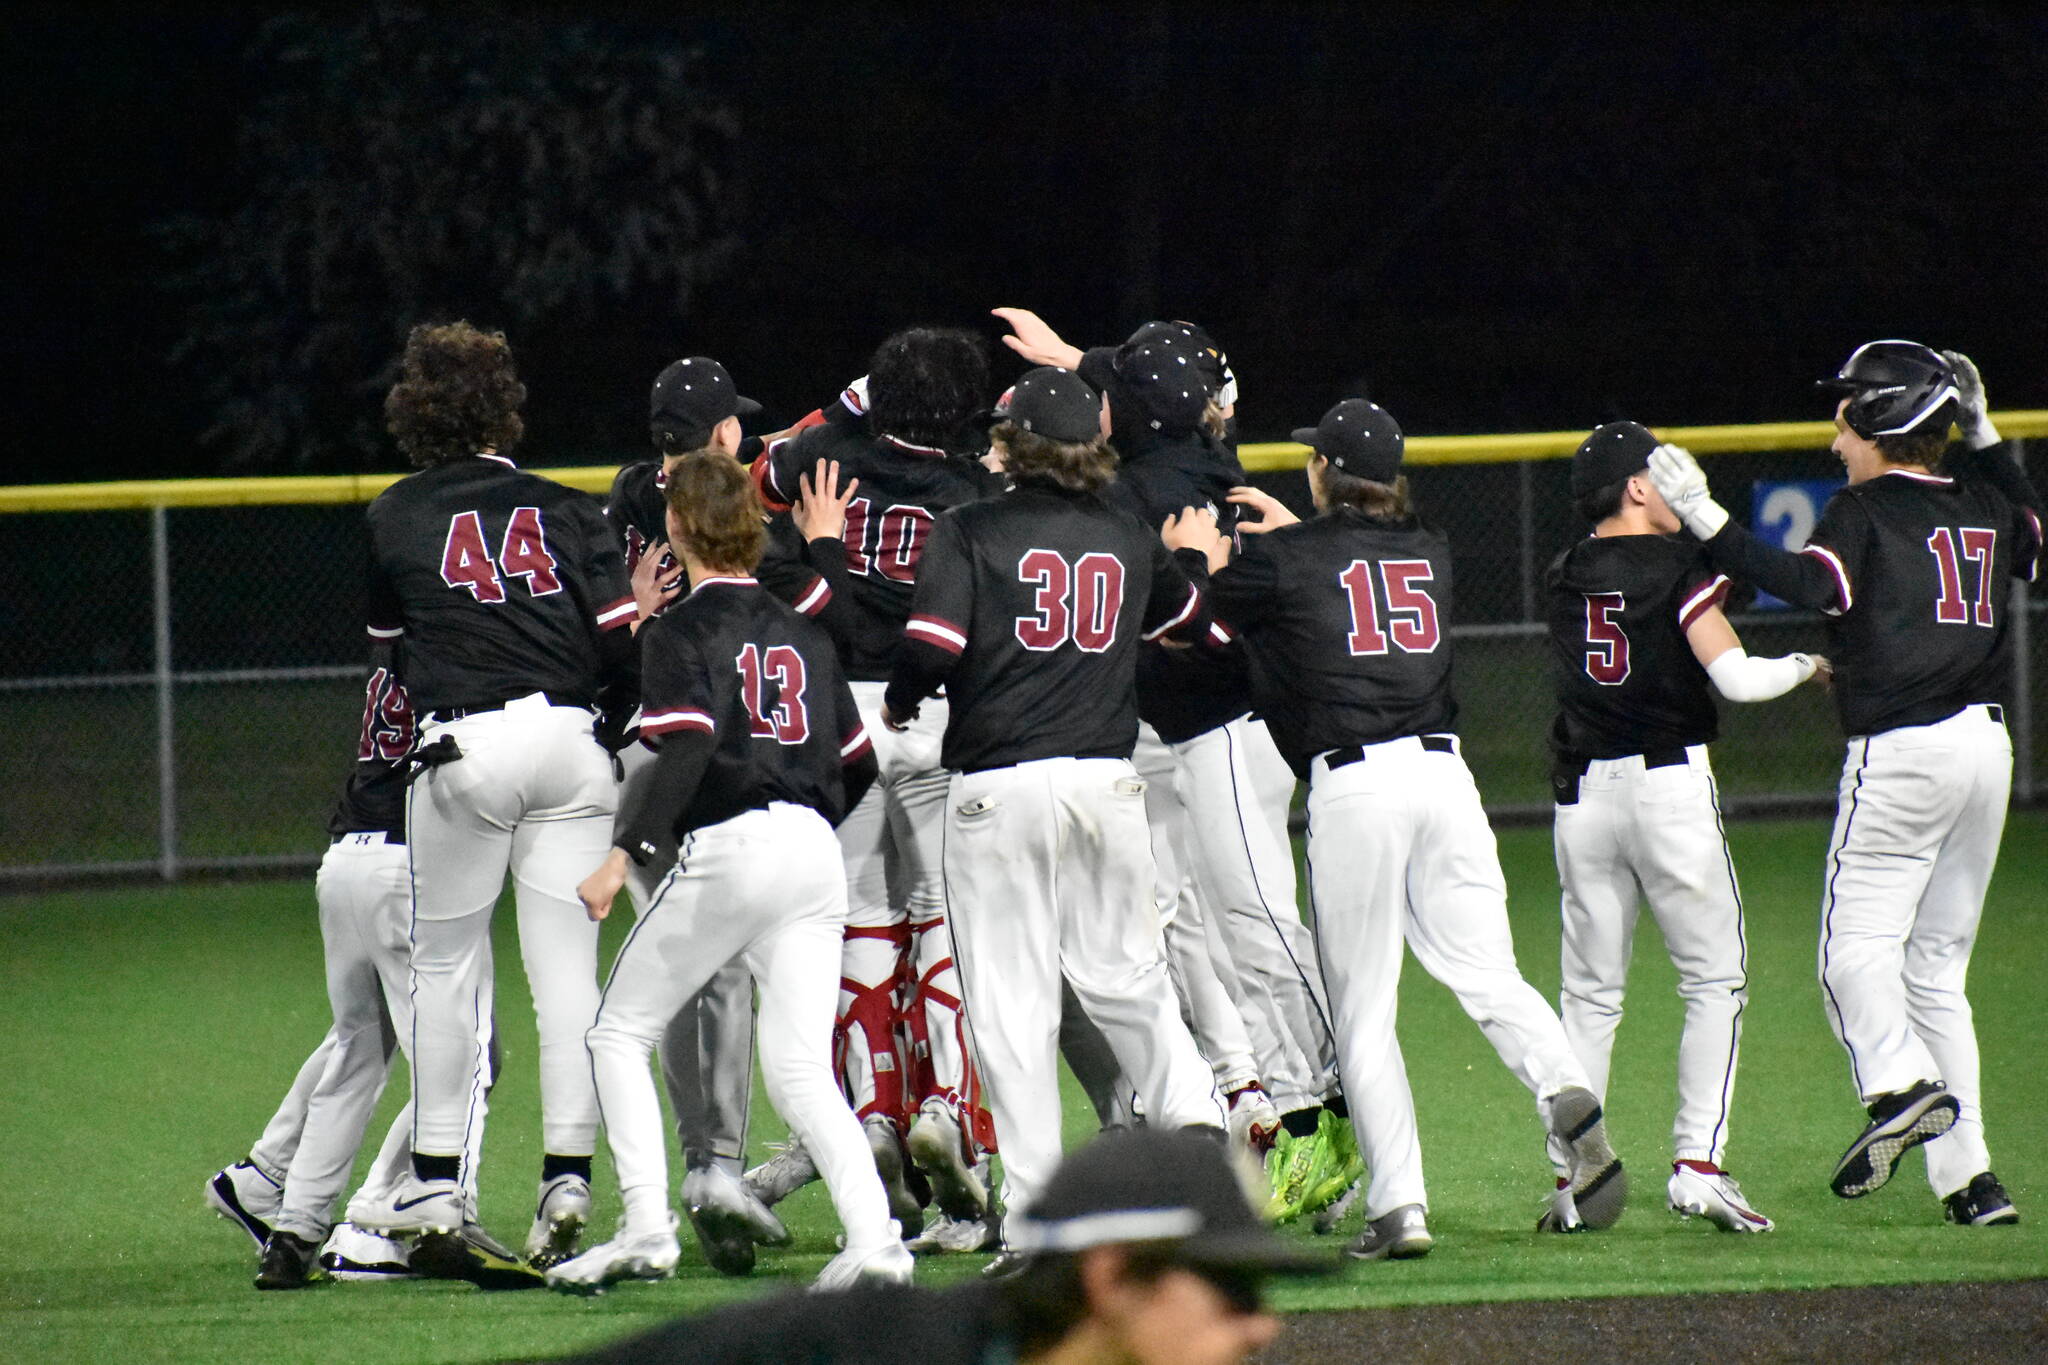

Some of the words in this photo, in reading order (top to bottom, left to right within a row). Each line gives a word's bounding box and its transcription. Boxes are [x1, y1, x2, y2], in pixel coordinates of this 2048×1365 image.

[440, 507, 563, 603] 44
[841, 497, 936, 585] 10
[1760, 486, 1817, 554] 2
[1014, 548, 1126, 653] 30
[1339, 559, 1441, 656] 15
[1927, 527, 1997, 628] 17
[1582, 590, 1632, 686] 5
[358, 667, 417, 762] 19
[735, 642, 808, 745] 13
